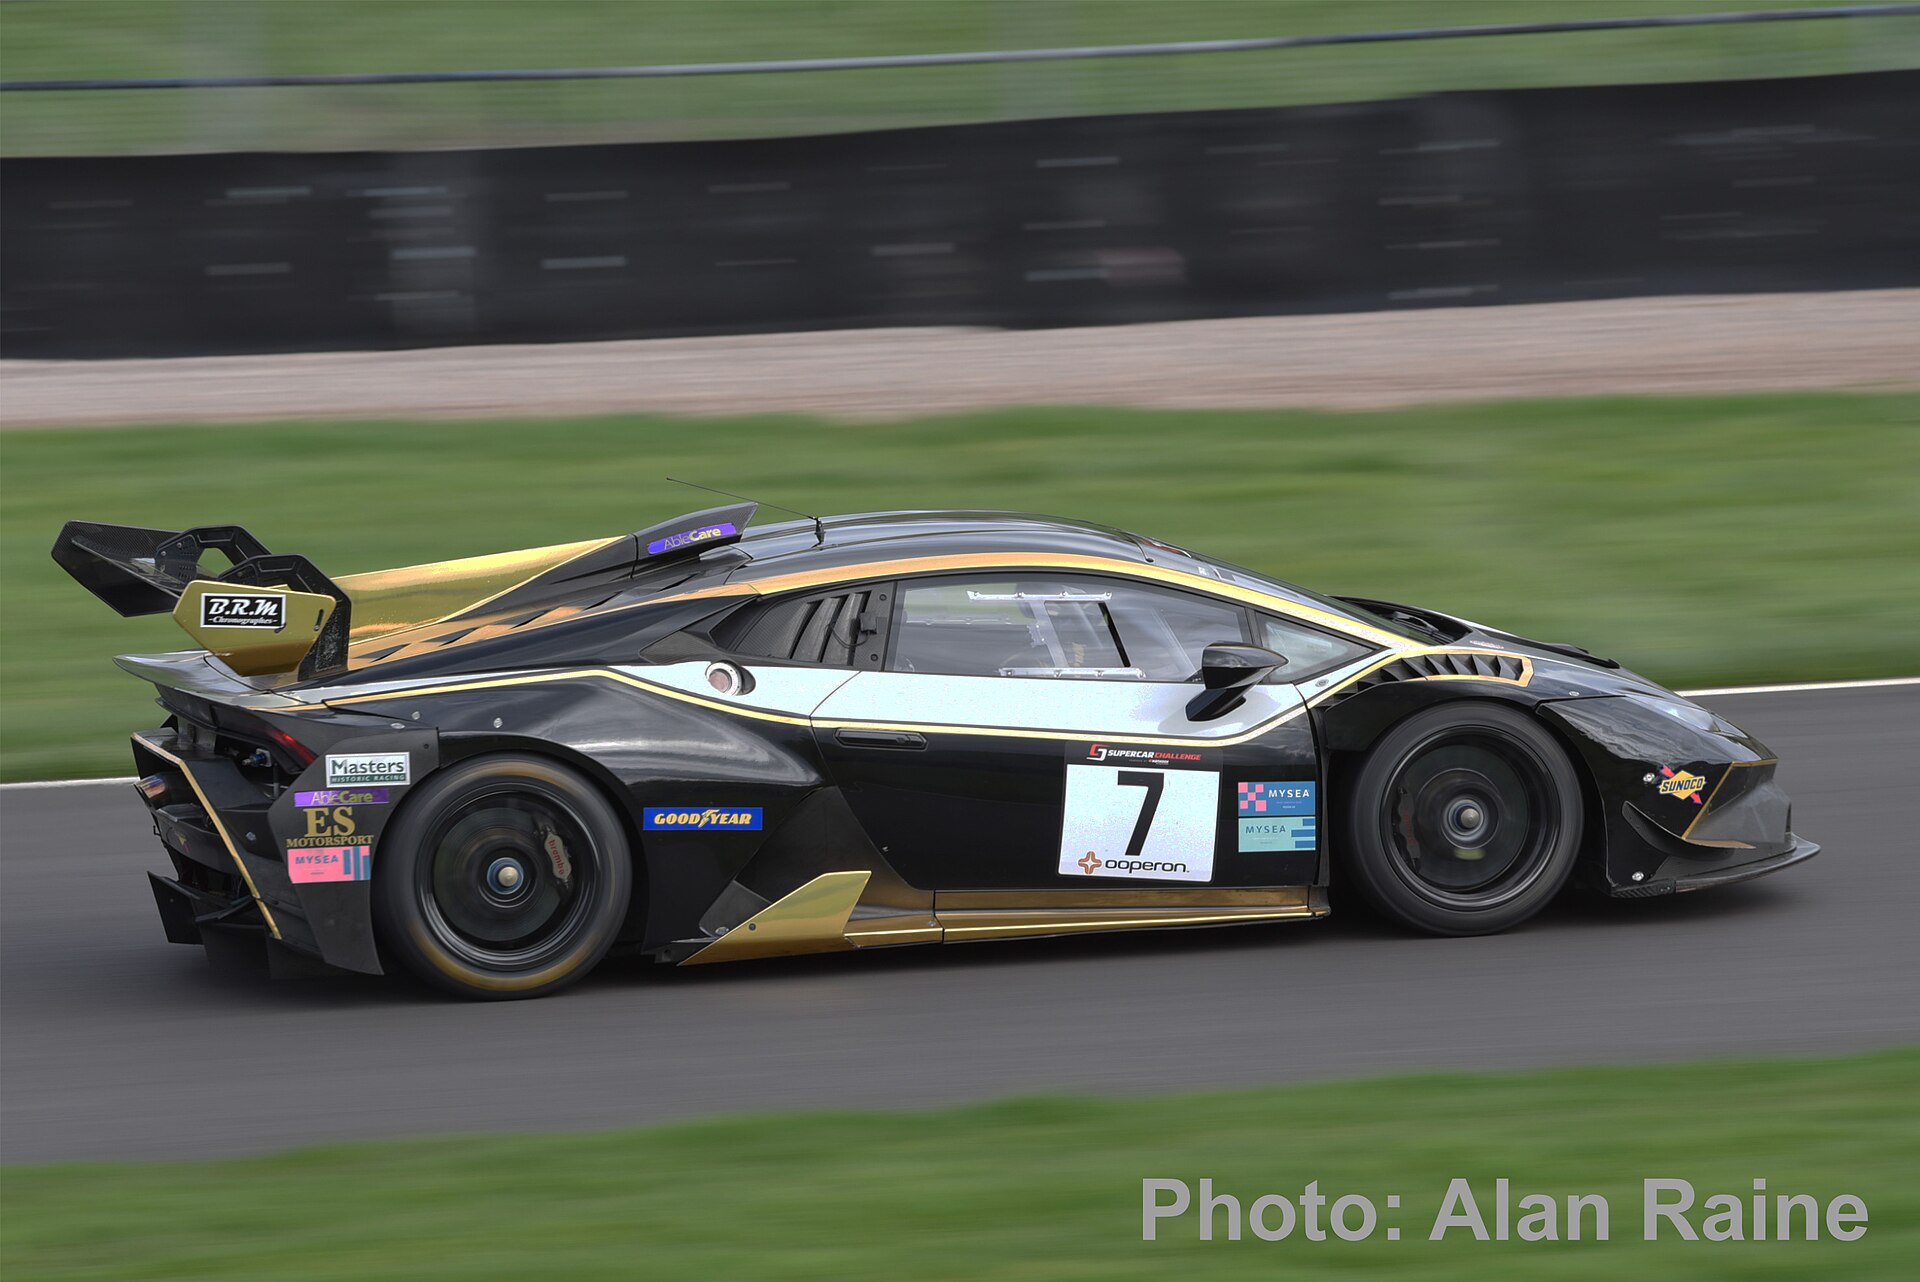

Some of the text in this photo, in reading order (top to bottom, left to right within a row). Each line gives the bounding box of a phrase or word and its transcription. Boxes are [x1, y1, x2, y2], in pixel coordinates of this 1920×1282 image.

[664, 528, 721, 550] AbleCare
[331, 758, 405, 775] Masters
[331, 773, 405, 783] HISTORIC RACING
[1661, 777, 1704, 793] SUNOCO
[1268, 788, 1310, 798] MYSEA
[654, 809, 752, 828] GOODYEAR
[1117, 770, 1165, 857] 7
[303, 806, 356, 838] ES
[1245, 824, 1287, 834] MYSEA
[286, 834, 375, 848] MOTORSPORT
[295, 854, 339, 865] MYSEA
